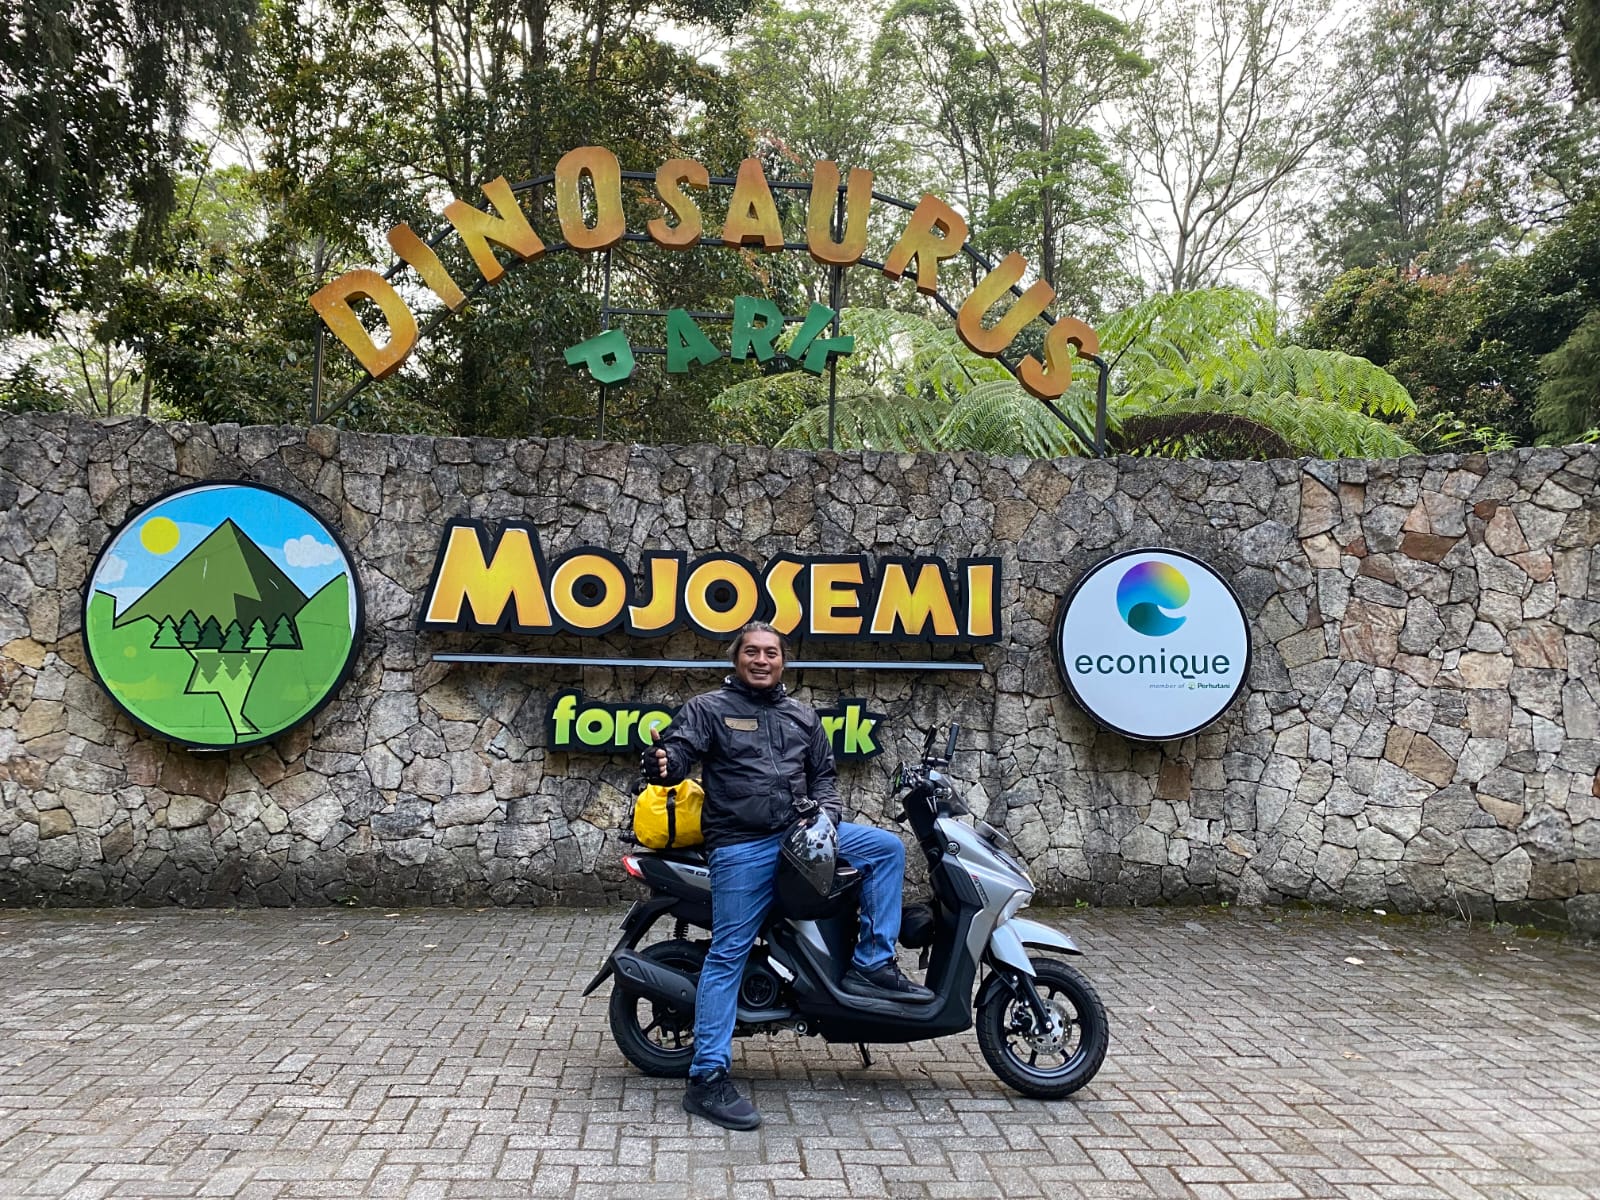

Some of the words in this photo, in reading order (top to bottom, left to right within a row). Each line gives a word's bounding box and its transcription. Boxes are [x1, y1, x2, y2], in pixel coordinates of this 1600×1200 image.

[310, 146, 1098, 399] DINOSAURUS
[563, 295, 855, 386] PARK
[425, 526, 994, 636] MOJOSEMI
[552, 694, 673, 746] fore
